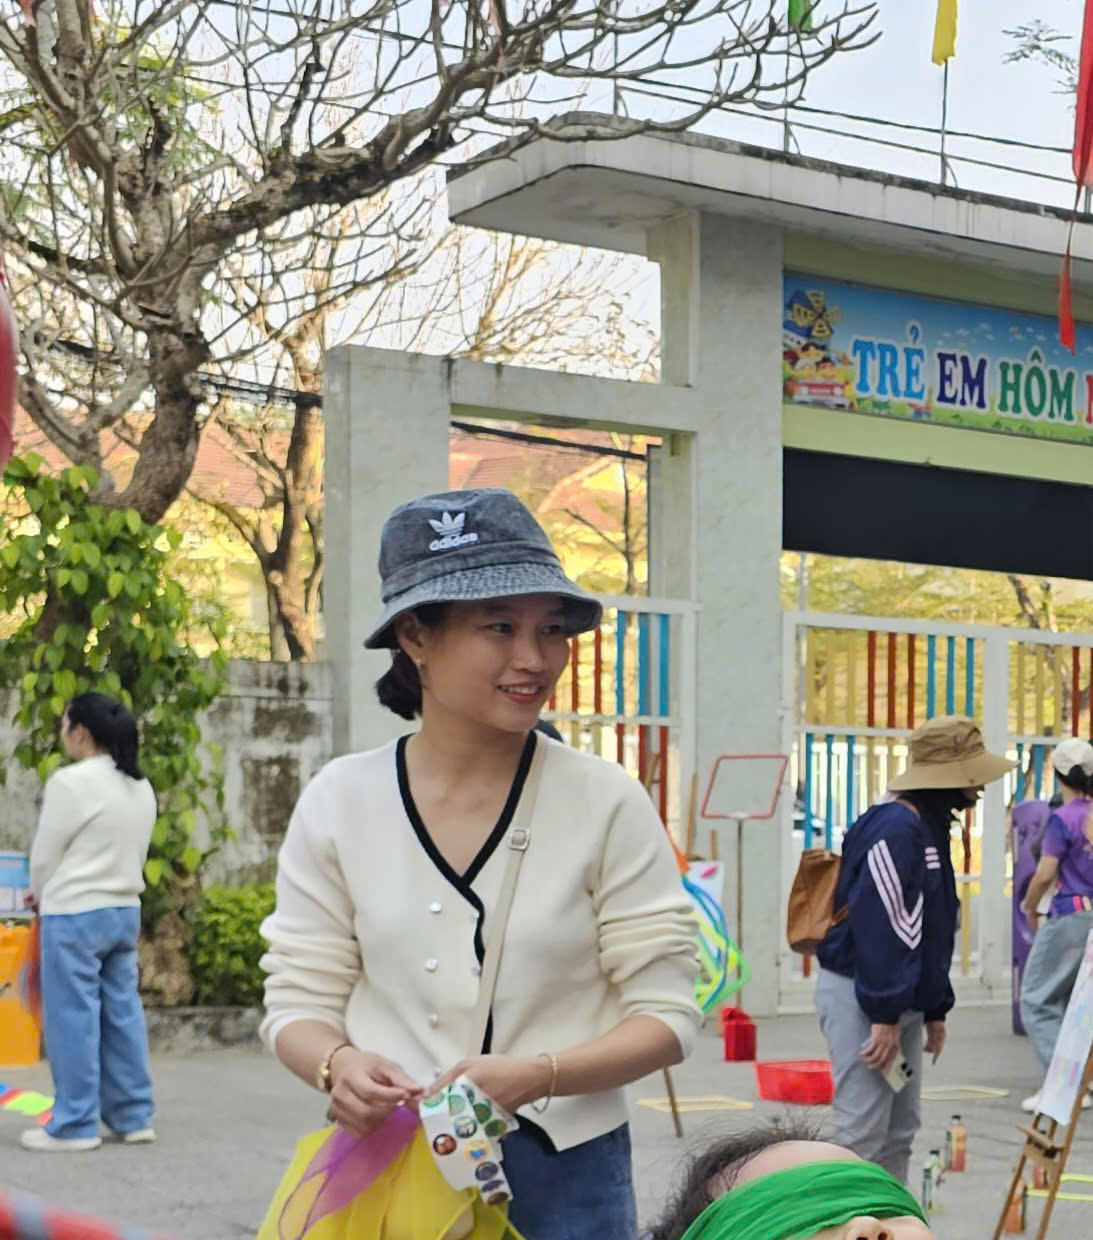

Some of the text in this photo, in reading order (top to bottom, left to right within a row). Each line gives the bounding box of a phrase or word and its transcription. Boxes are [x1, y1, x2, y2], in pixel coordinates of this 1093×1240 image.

[853, 324, 925, 400] TRẺ
[936, 353, 987, 409] EM
[998, 350, 1076, 422] HÔM
[428, 532, 479, 552] adidas
